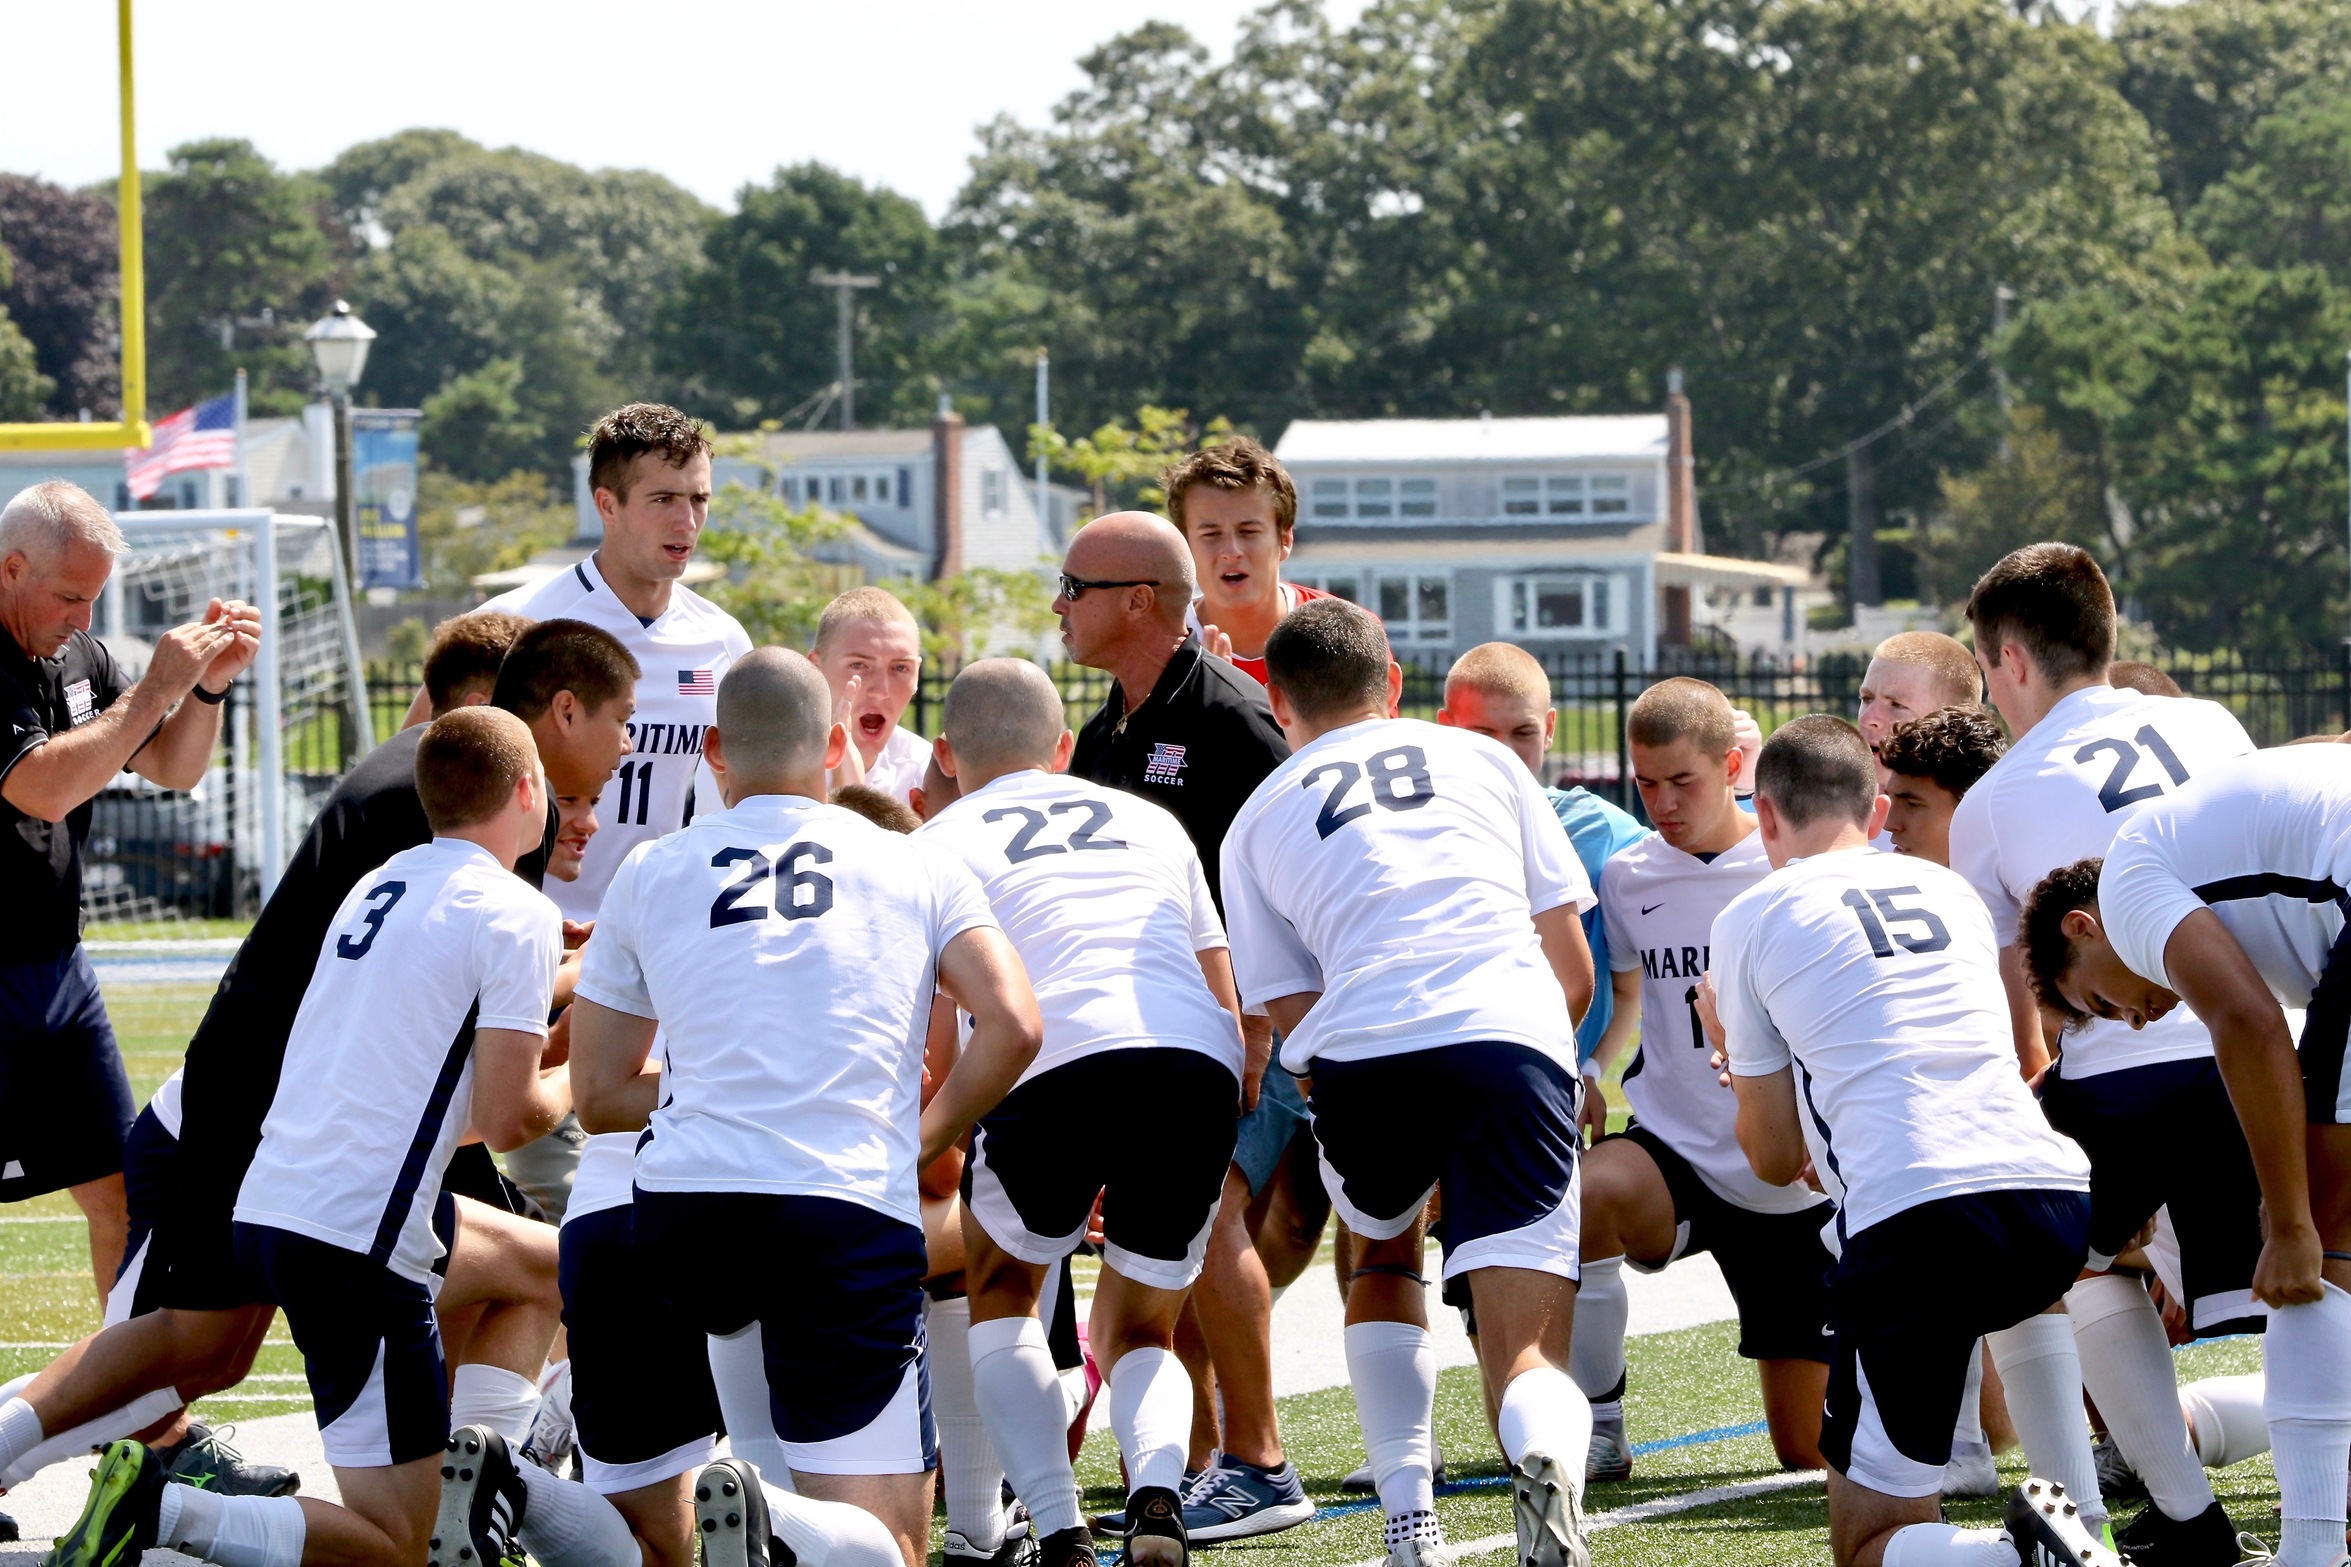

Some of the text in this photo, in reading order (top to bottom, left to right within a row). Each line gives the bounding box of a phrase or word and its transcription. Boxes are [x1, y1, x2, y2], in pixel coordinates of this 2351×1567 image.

[72, 708, 101, 726] SOCCER
[625, 722, 709, 754] RITIM
[1143, 774, 1184, 786] SOCCER
[1152, 755, 1182, 766] MARITIME
[1301, 745, 1436, 841] 28
[2073, 724, 2191, 814] 21
[617, 761, 653, 826] 11
[981, 799, 1130, 865] 22
[710, 841, 833, 929] 26
[336, 880, 406, 961] 3
[1840, 885, 1952, 959] 15
[1640, 945, 1711, 979] MARI
[1684, 985, 1705, 1049] 1
